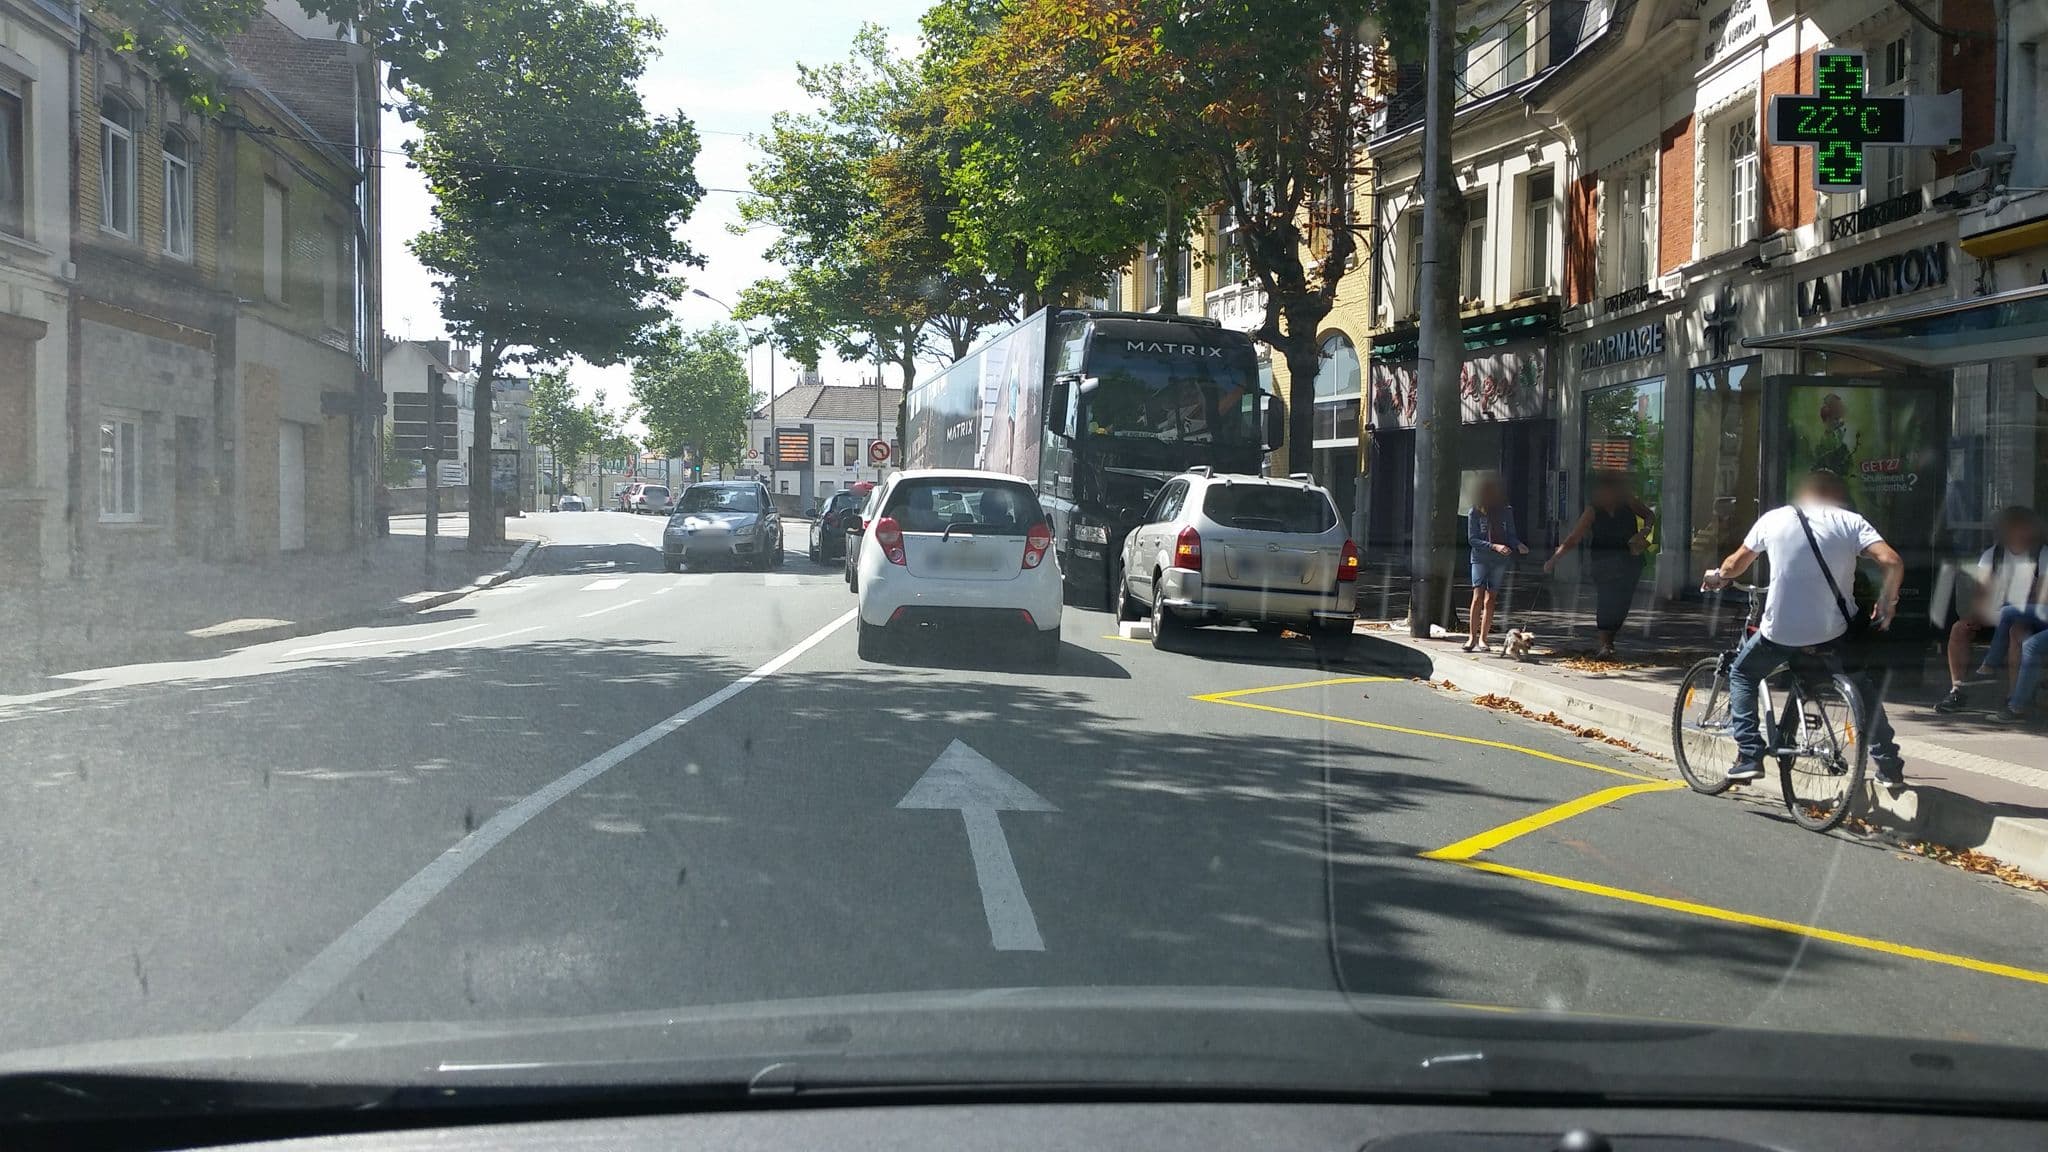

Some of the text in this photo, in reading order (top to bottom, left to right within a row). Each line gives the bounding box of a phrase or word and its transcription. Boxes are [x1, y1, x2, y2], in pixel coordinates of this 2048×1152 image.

[1798, 105, 1880, 134] 22°C
[1798, 241, 1948, 317] LA NATION
[1127, 340, 1222, 358] MATRIX
[1580, 322, 1665, 370] PHARMACIE
[946, 419, 974, 442] MATRIX
[1861, 460, 1884, 473] GET
